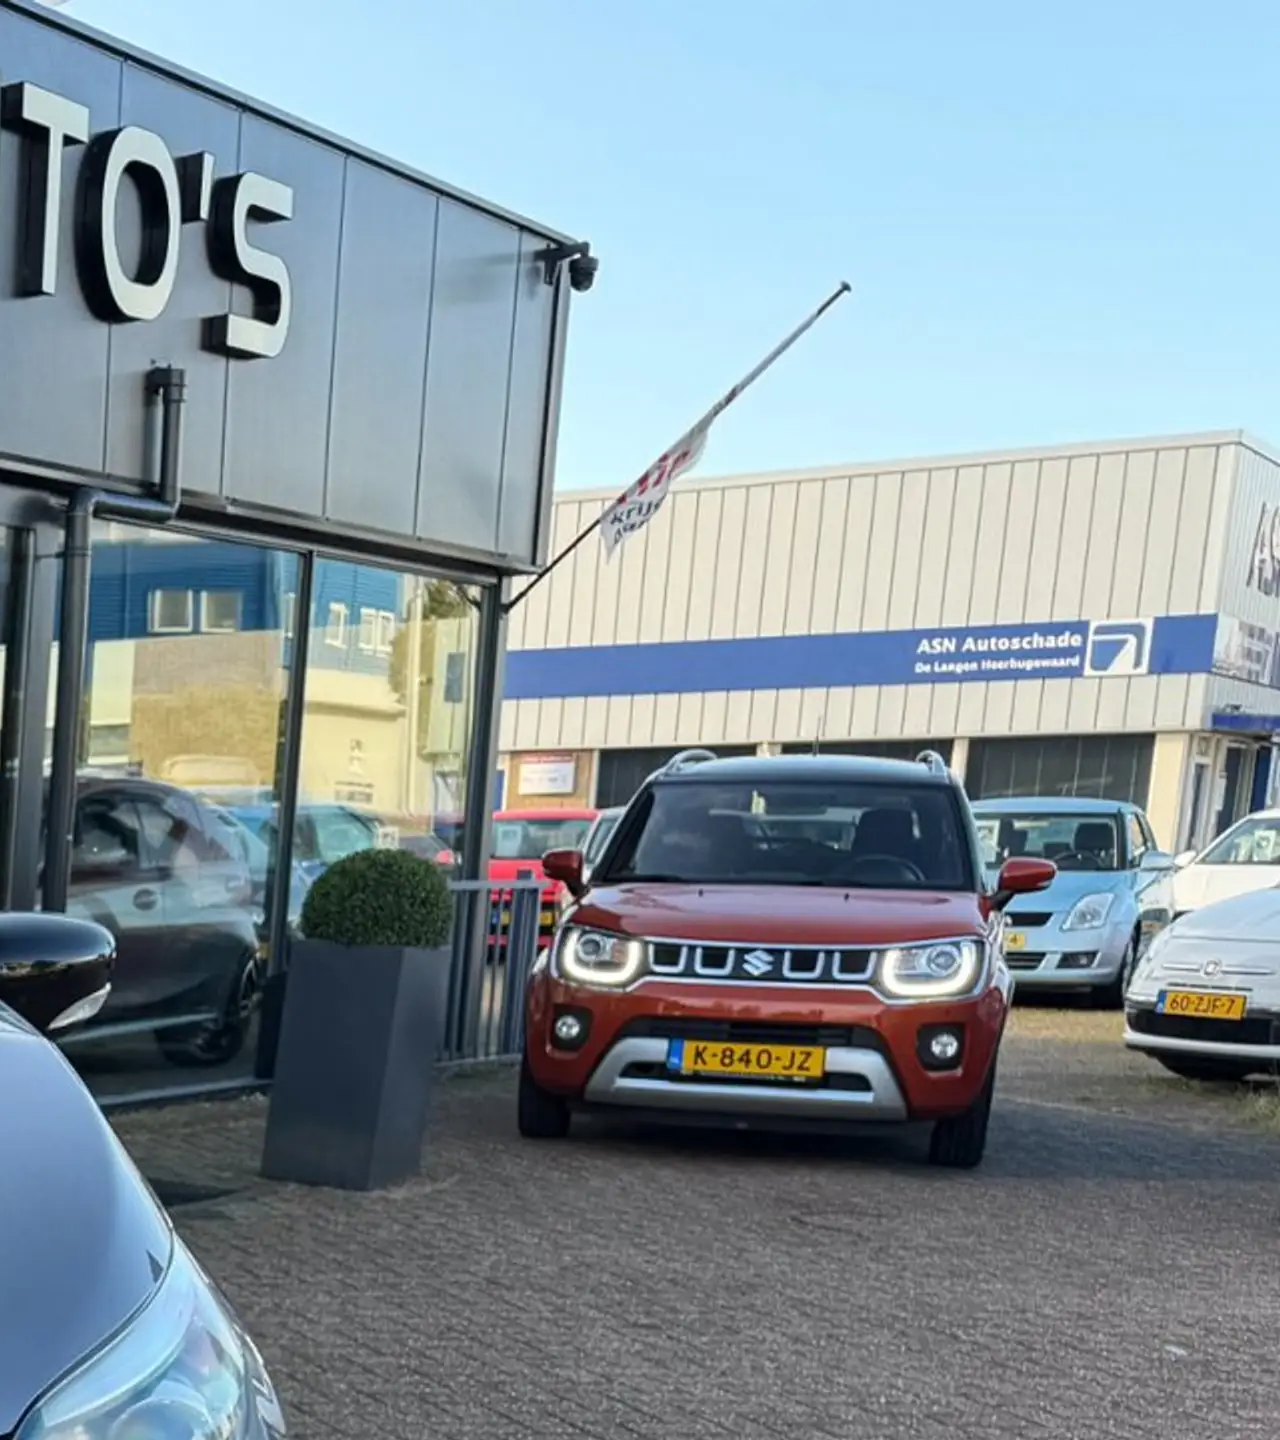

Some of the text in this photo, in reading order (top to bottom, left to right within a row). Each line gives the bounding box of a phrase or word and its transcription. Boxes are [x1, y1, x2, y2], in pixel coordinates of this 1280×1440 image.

[916, 631, 1083, 655] ASN Autoschade
[915, 661, 931, 674] De
[1170, 995, 1236, 1015] 60-ZJF-7
[693, 1045, 813, 1072] K-840-JZ
